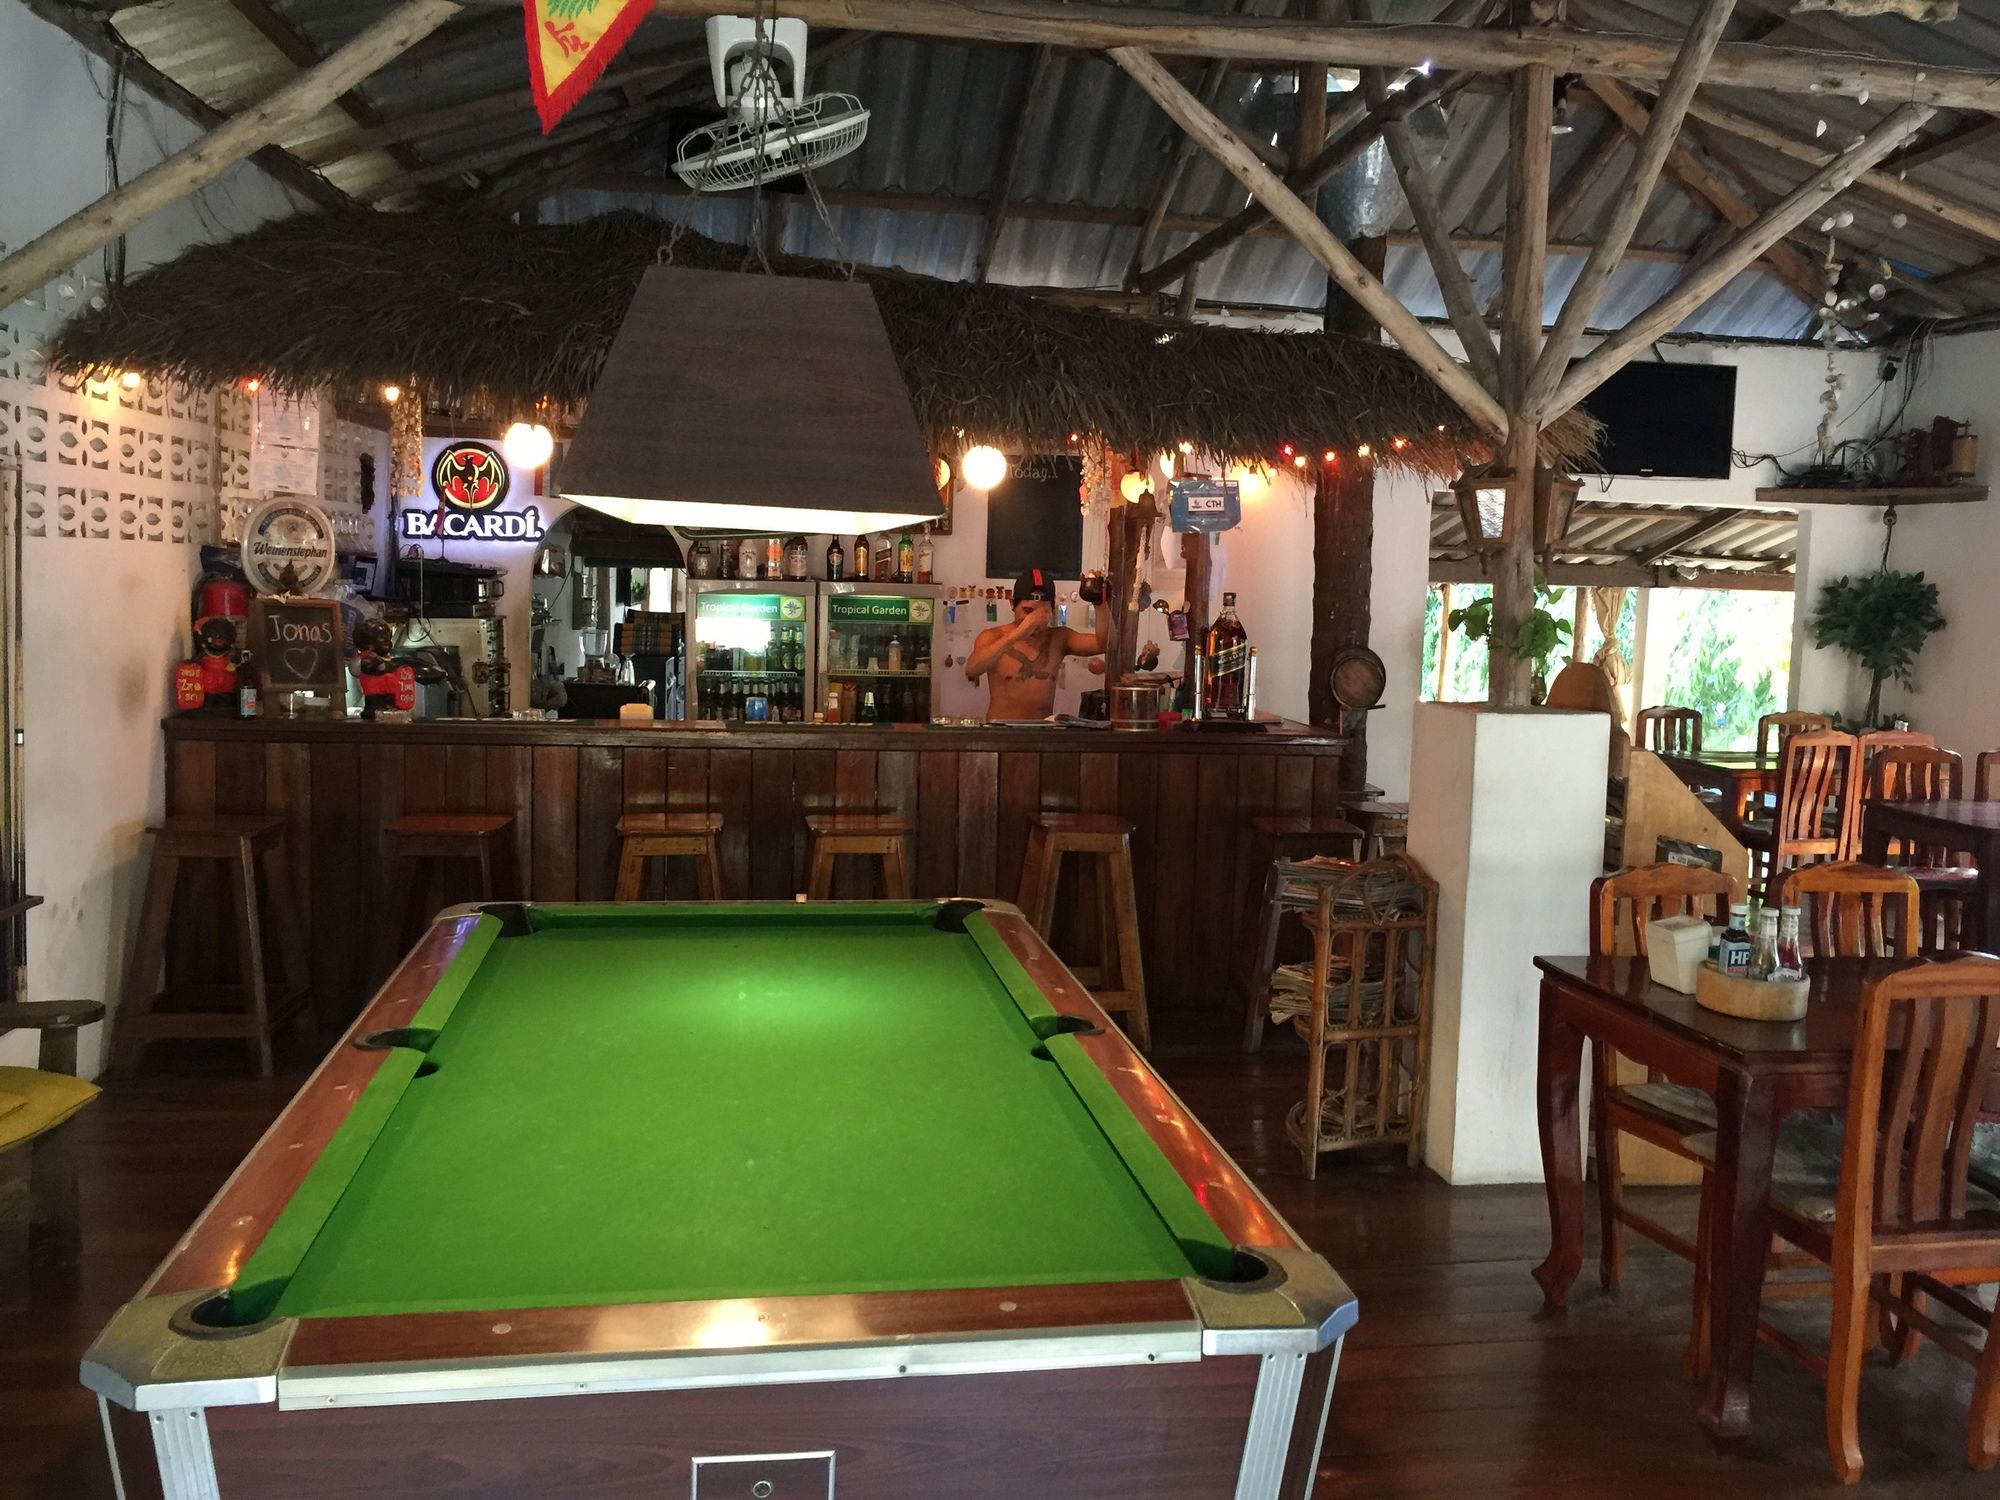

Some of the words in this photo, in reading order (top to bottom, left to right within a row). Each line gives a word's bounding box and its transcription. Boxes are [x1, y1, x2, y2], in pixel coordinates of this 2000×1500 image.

[1205, 500, 1222, 508] CTH
[832, 604, 869, 615] Tropical
[872, 605, 907, 615] Garden
[268, 614, 332, 643] Jonas
[1730, 950, 1750, 965] HP
